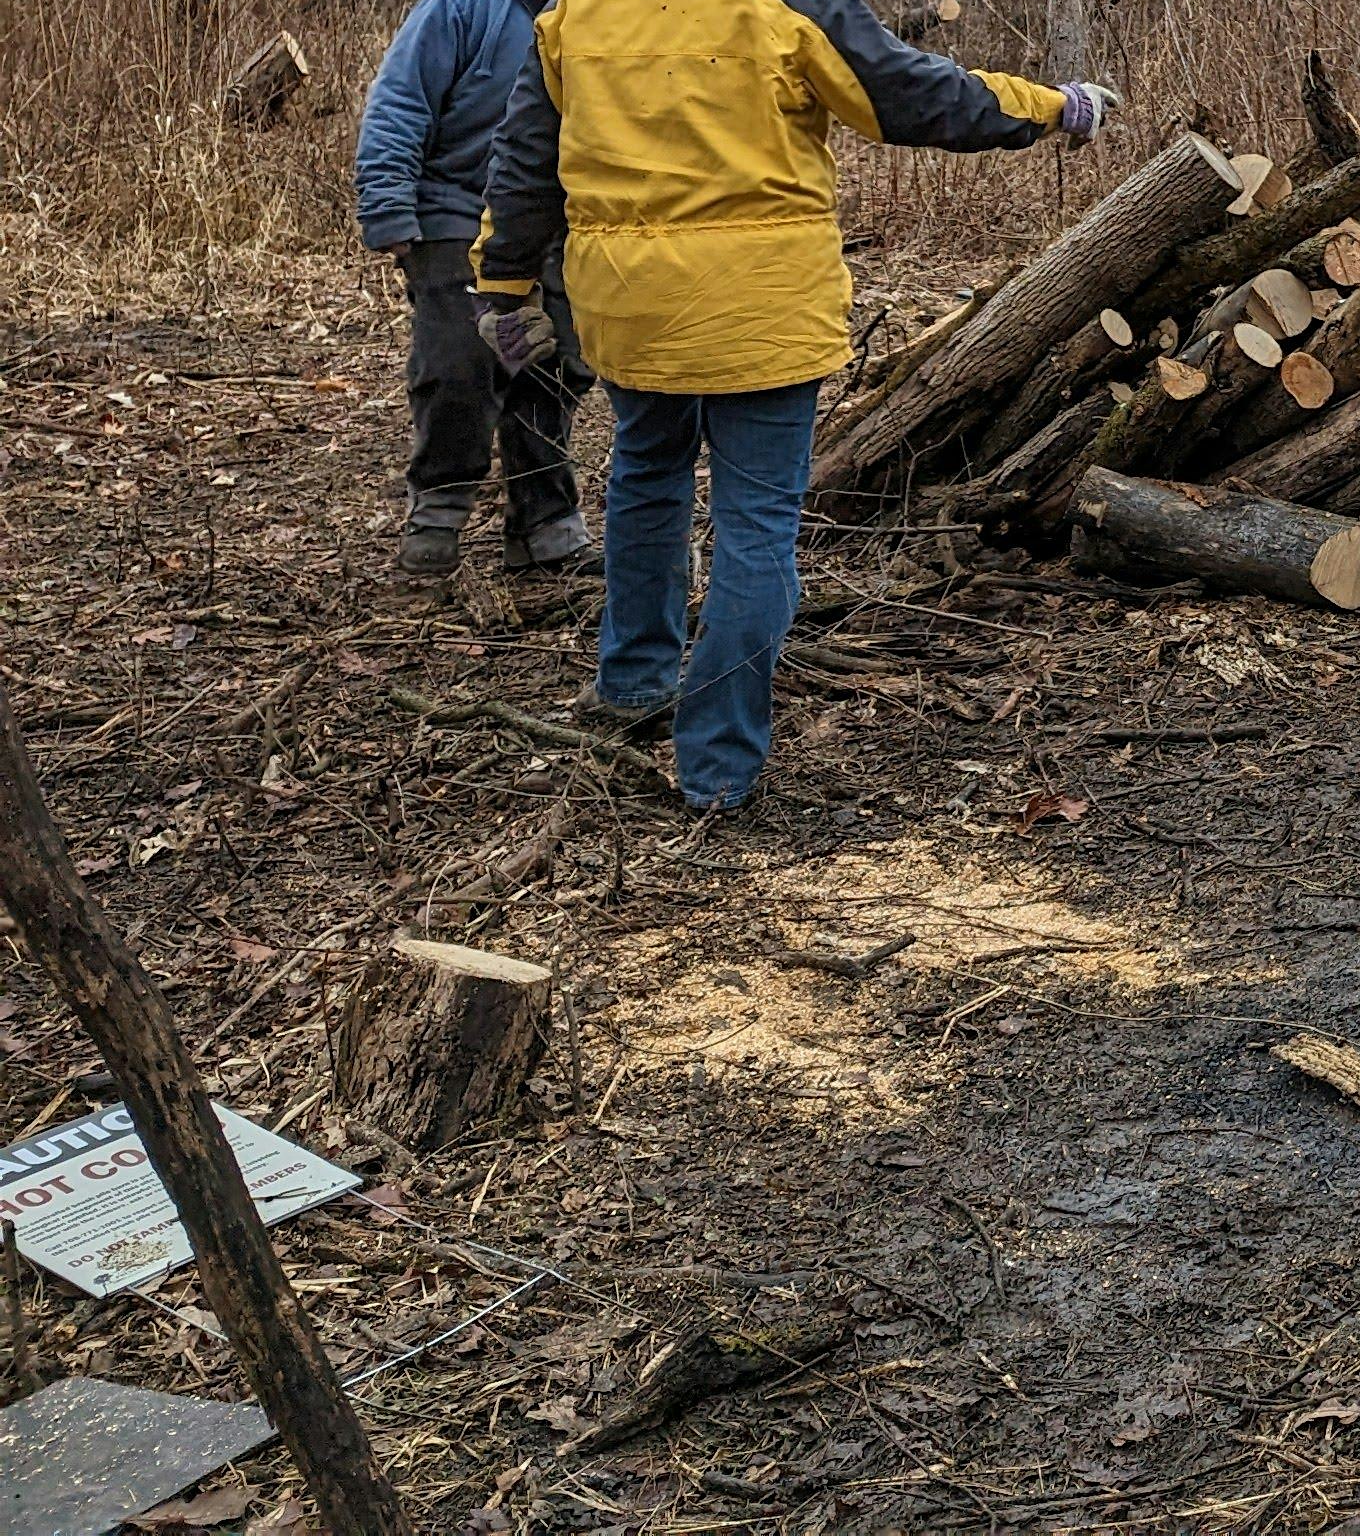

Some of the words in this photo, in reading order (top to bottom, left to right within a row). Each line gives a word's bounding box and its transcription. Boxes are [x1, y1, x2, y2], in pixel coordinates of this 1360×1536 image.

[0, 1109, 134, 1180] AUTIO
[0, 1175, 75, 1219] HOT
[81, 1149, 148, 1180] CO
[67, 1254, 95, 1268] DO
[96, 1238, 130, 1257] NOT
[131, 1219, 178, 1241] TAMP
